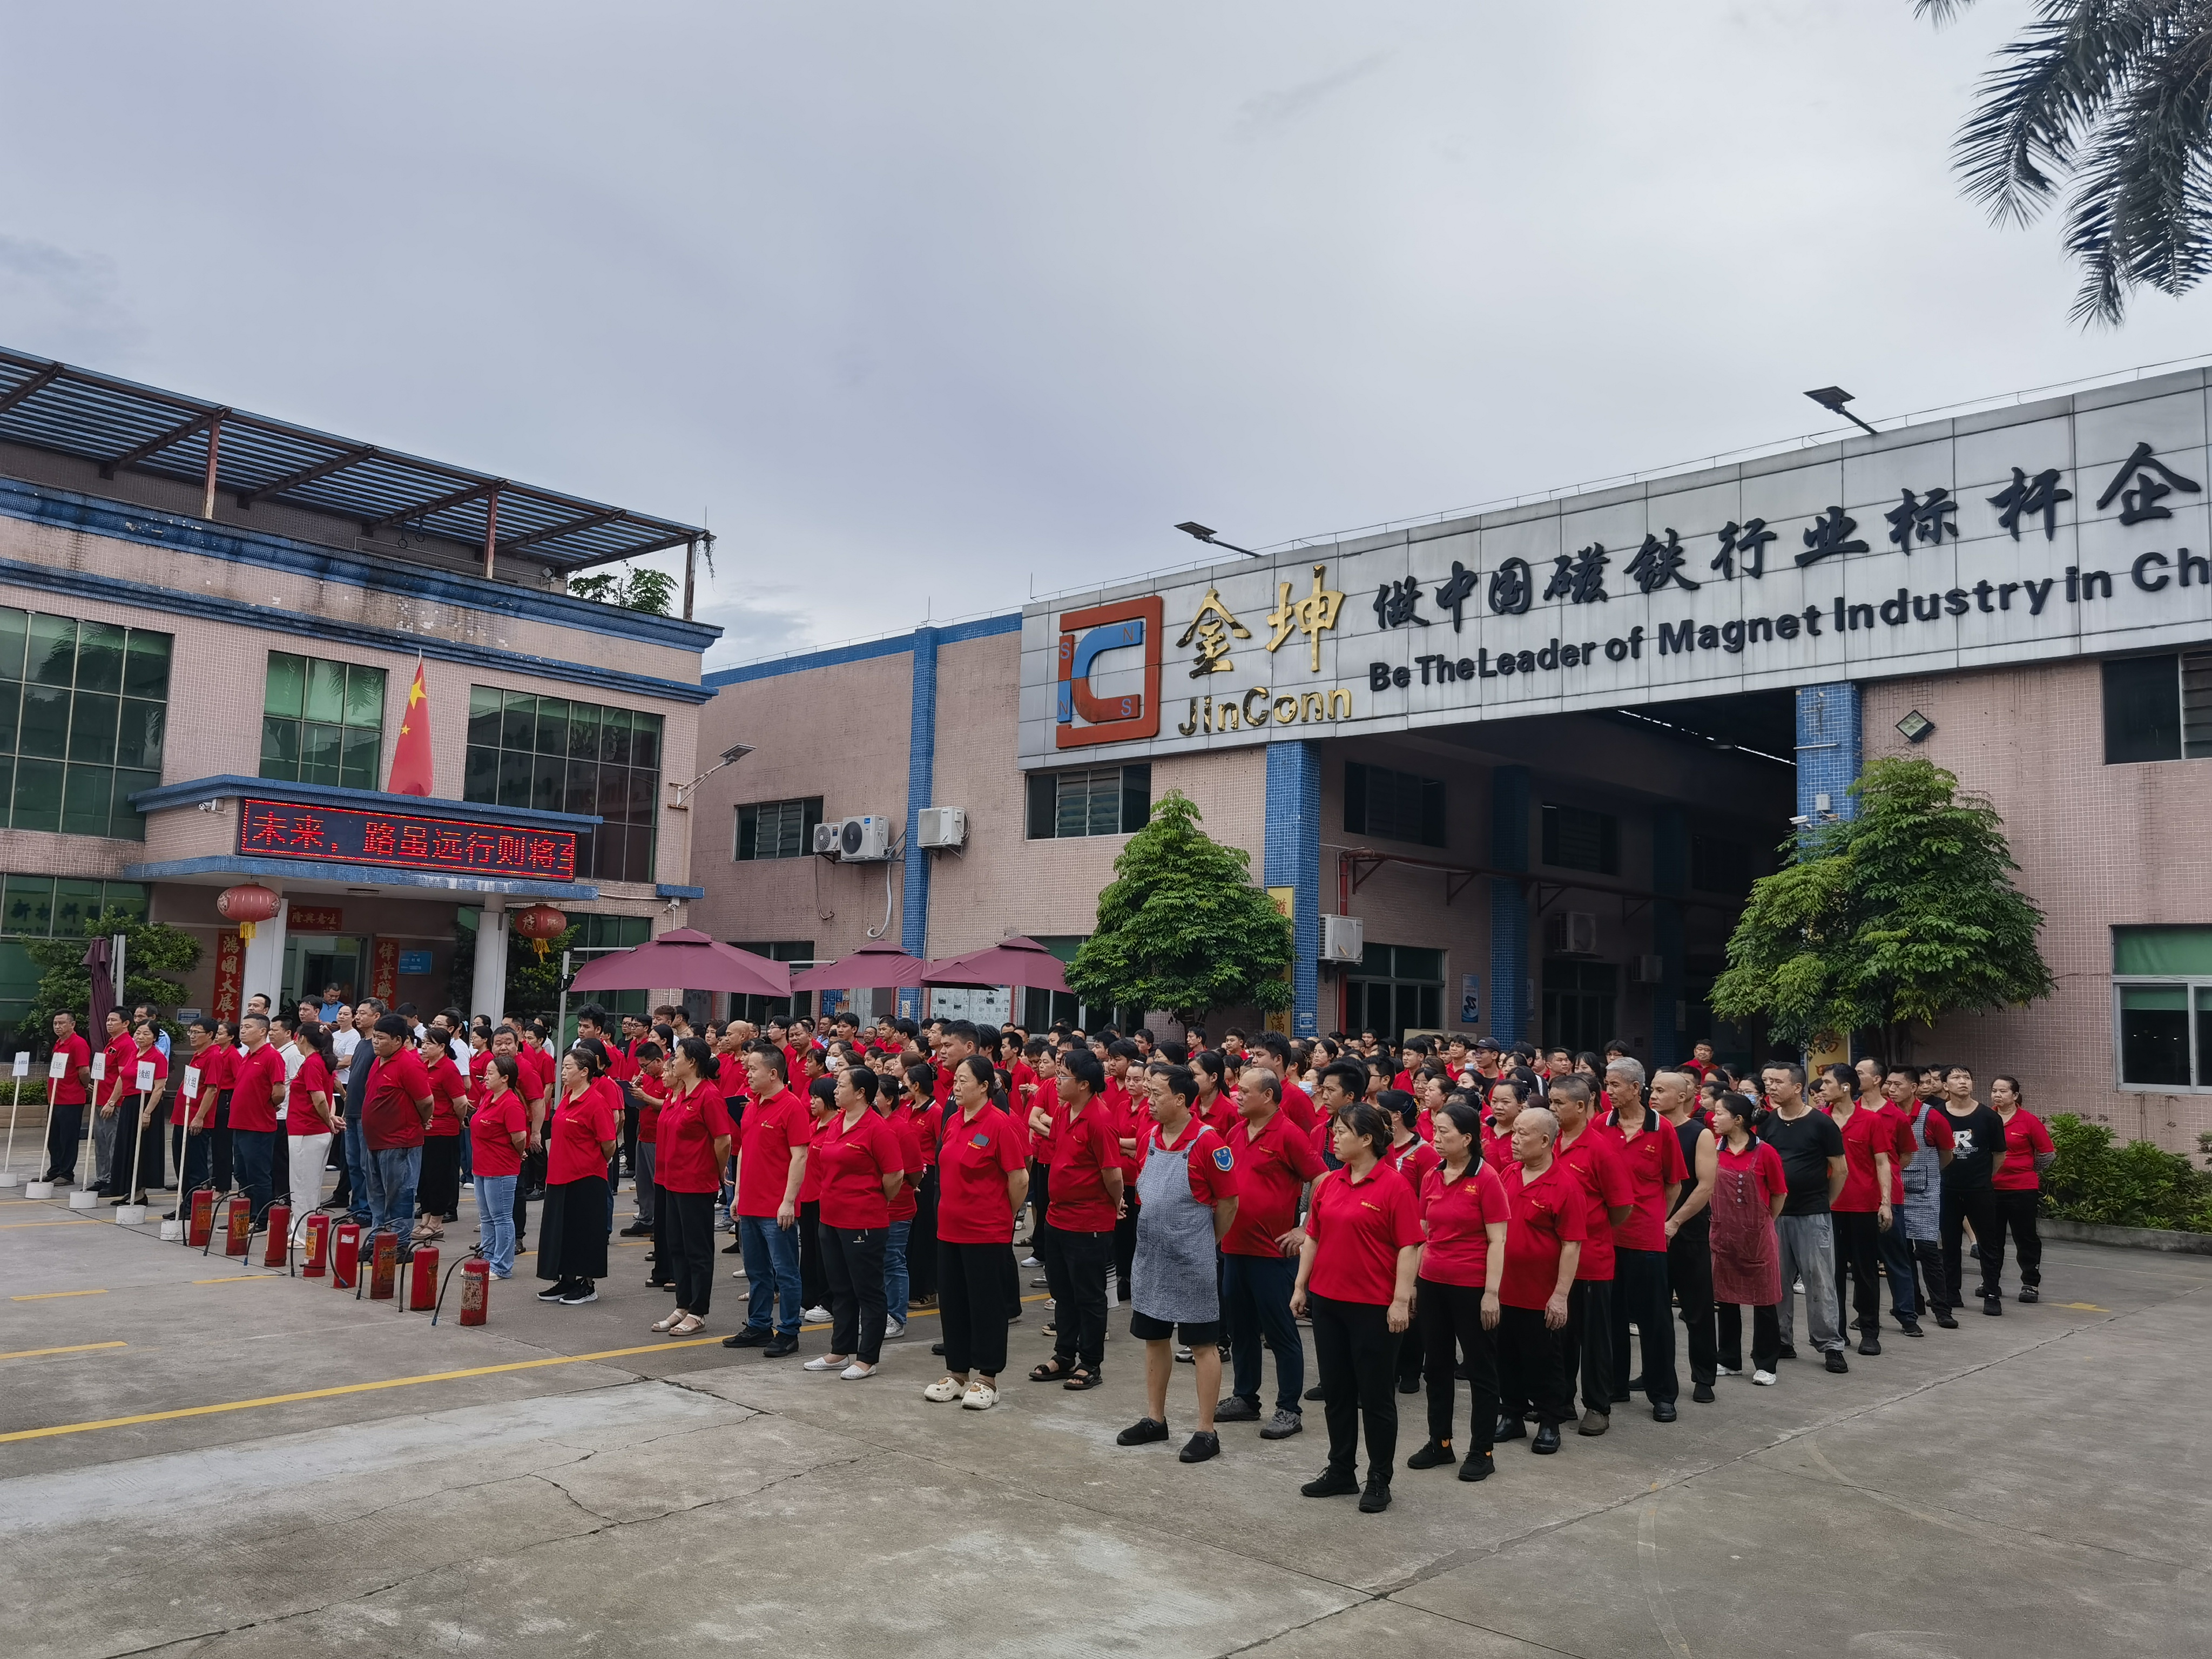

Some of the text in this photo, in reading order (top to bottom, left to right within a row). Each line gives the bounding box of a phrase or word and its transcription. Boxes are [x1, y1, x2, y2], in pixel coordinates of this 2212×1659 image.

[1373, 442, 2201, 632] 做中国磁铁行业标杆企
[1122, 625, 1134, 643] N
[1176, 563, 1345, 679] 金坤
[1370, 662, 1410, 691] Be
[1604, 626, 1643, 662] of
[1658, 605, 1822, 655] Magnet
[1834, 577, 2053, 632] Industry
[2065, 566, 2112, 601] in
[2131, 547, 2210, 592] Ch
[1060, 642, 1070, 659] S
[1058, 699, 1068, 716] N
[1121, 698, 1131, 716] S
[1178, 686, 1352, 736] JinConn
